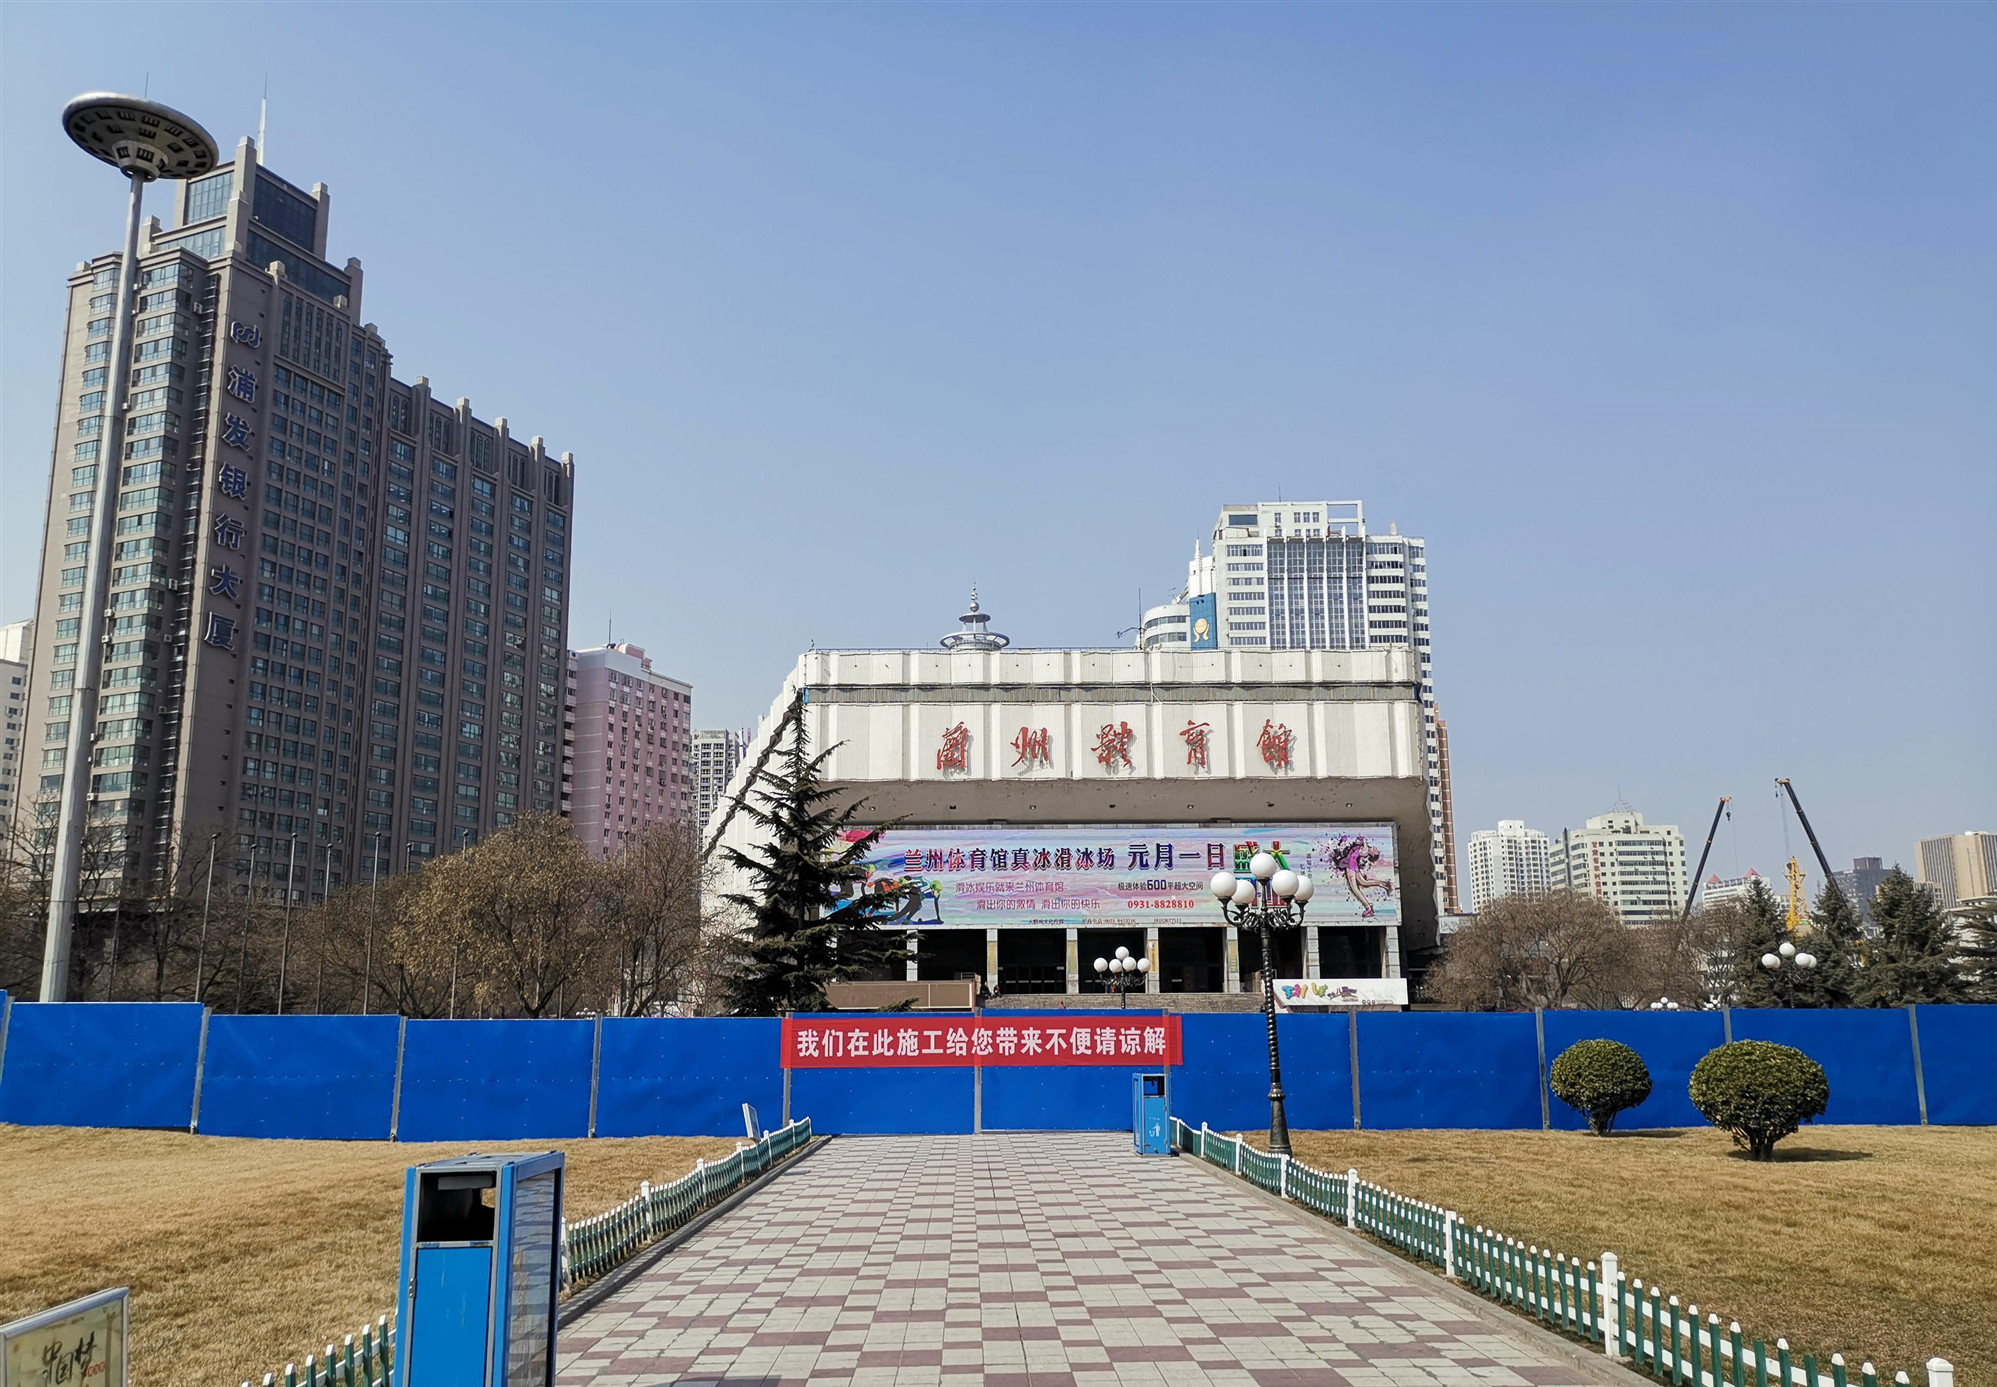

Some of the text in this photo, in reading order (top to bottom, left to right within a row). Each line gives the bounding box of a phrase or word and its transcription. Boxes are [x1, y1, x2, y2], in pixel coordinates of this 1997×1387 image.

[204, 364, 258, 650] 浦发银行大厦
[904, 842, 1226, 872] 兰州体育馆真冰滑冰场 元月一日
[976, 898, 1101, 911] 滑出你的激情 滑出你的快乐
[1127, 899, 1195, 909] 0931-8828810
[796, 1026, 1167, 1058] 我们在此施工给您带来不便请谅解
[42, 1331, 98, 1386] 中国梦
